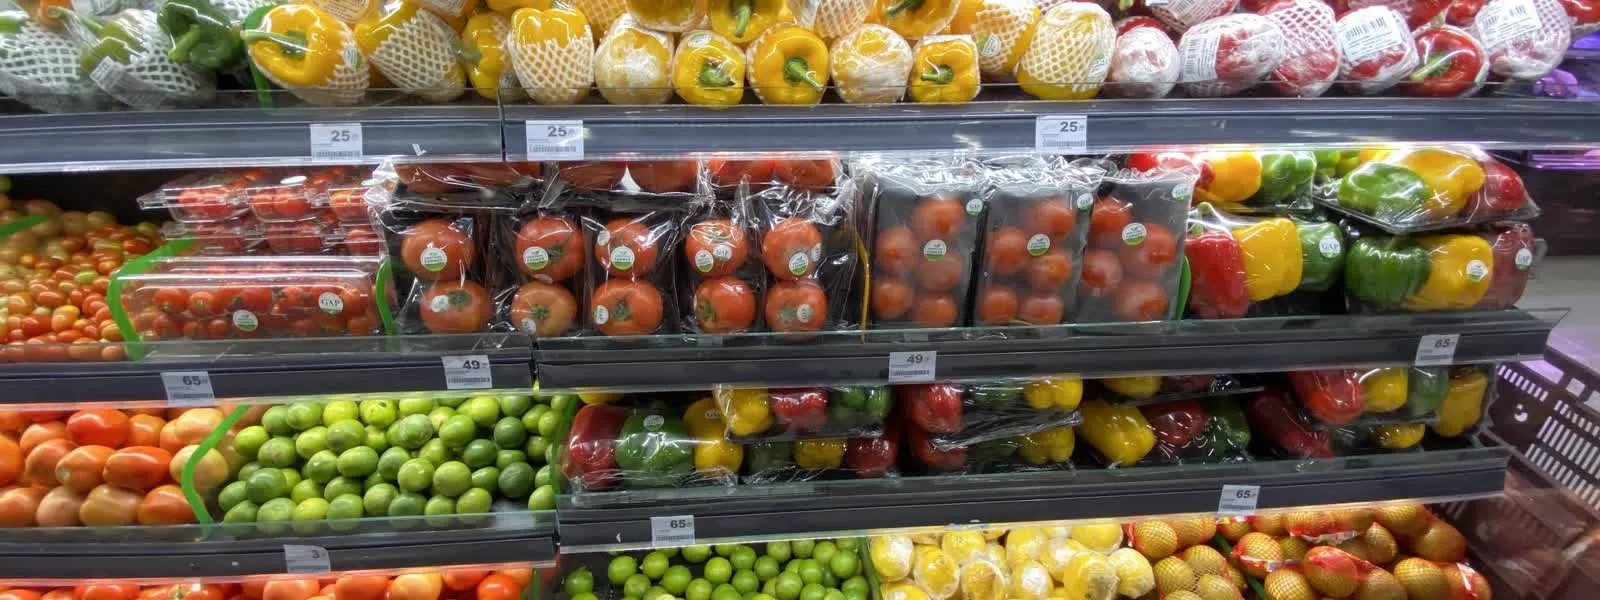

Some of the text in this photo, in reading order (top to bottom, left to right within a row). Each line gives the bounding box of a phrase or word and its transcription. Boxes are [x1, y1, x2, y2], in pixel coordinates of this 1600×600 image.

[548, 126, 568, 137] 25
[1060, 121, 1079, 133] 25
[331, 130, 350, 142] 25
[321, 297, 341, 307] GAP
[1434, 339, 1450, 349] 65
[907, 354, 923, 364] 49
[463, 360, 480, 370] 49
[182, 376, 201, 386] 65
[1236, 490, 1250, 499] 65
[670, 520, 686, 529] 65
[311, 550, 320, 559] 3
